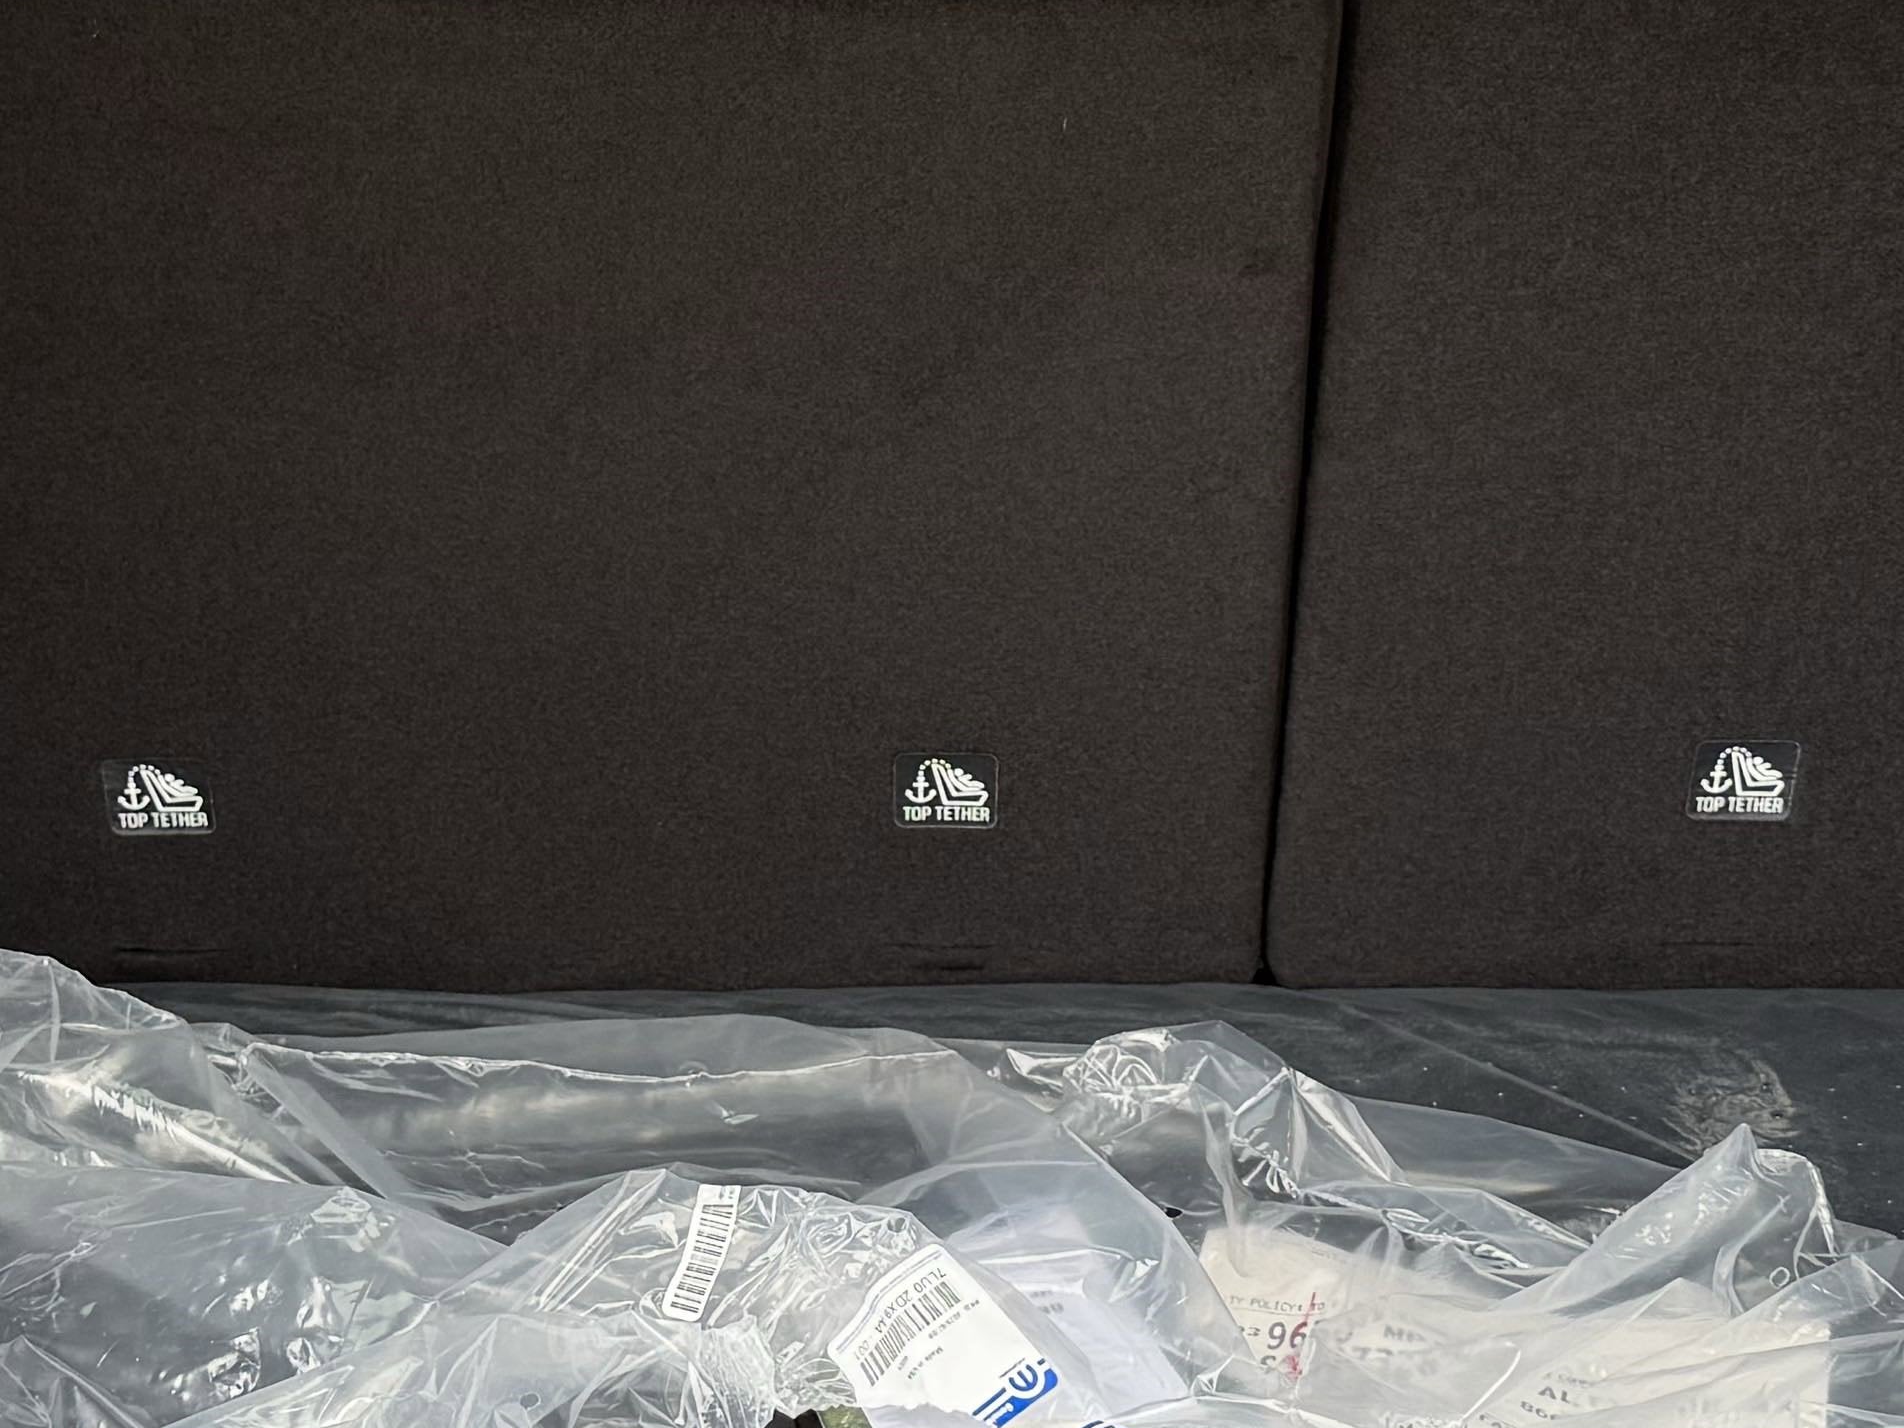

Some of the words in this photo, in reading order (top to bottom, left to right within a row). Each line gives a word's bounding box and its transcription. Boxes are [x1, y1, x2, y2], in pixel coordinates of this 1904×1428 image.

[902, 805, 932, 822] TOP
[934, 805, 990, 823] TETHER
[1696, 796, 1726, 813] TOP
[1727, 796, 1785, 814] TETHER
[117, 812, 148, 829] TOP
[150, 811, 209, 828] TETHER
